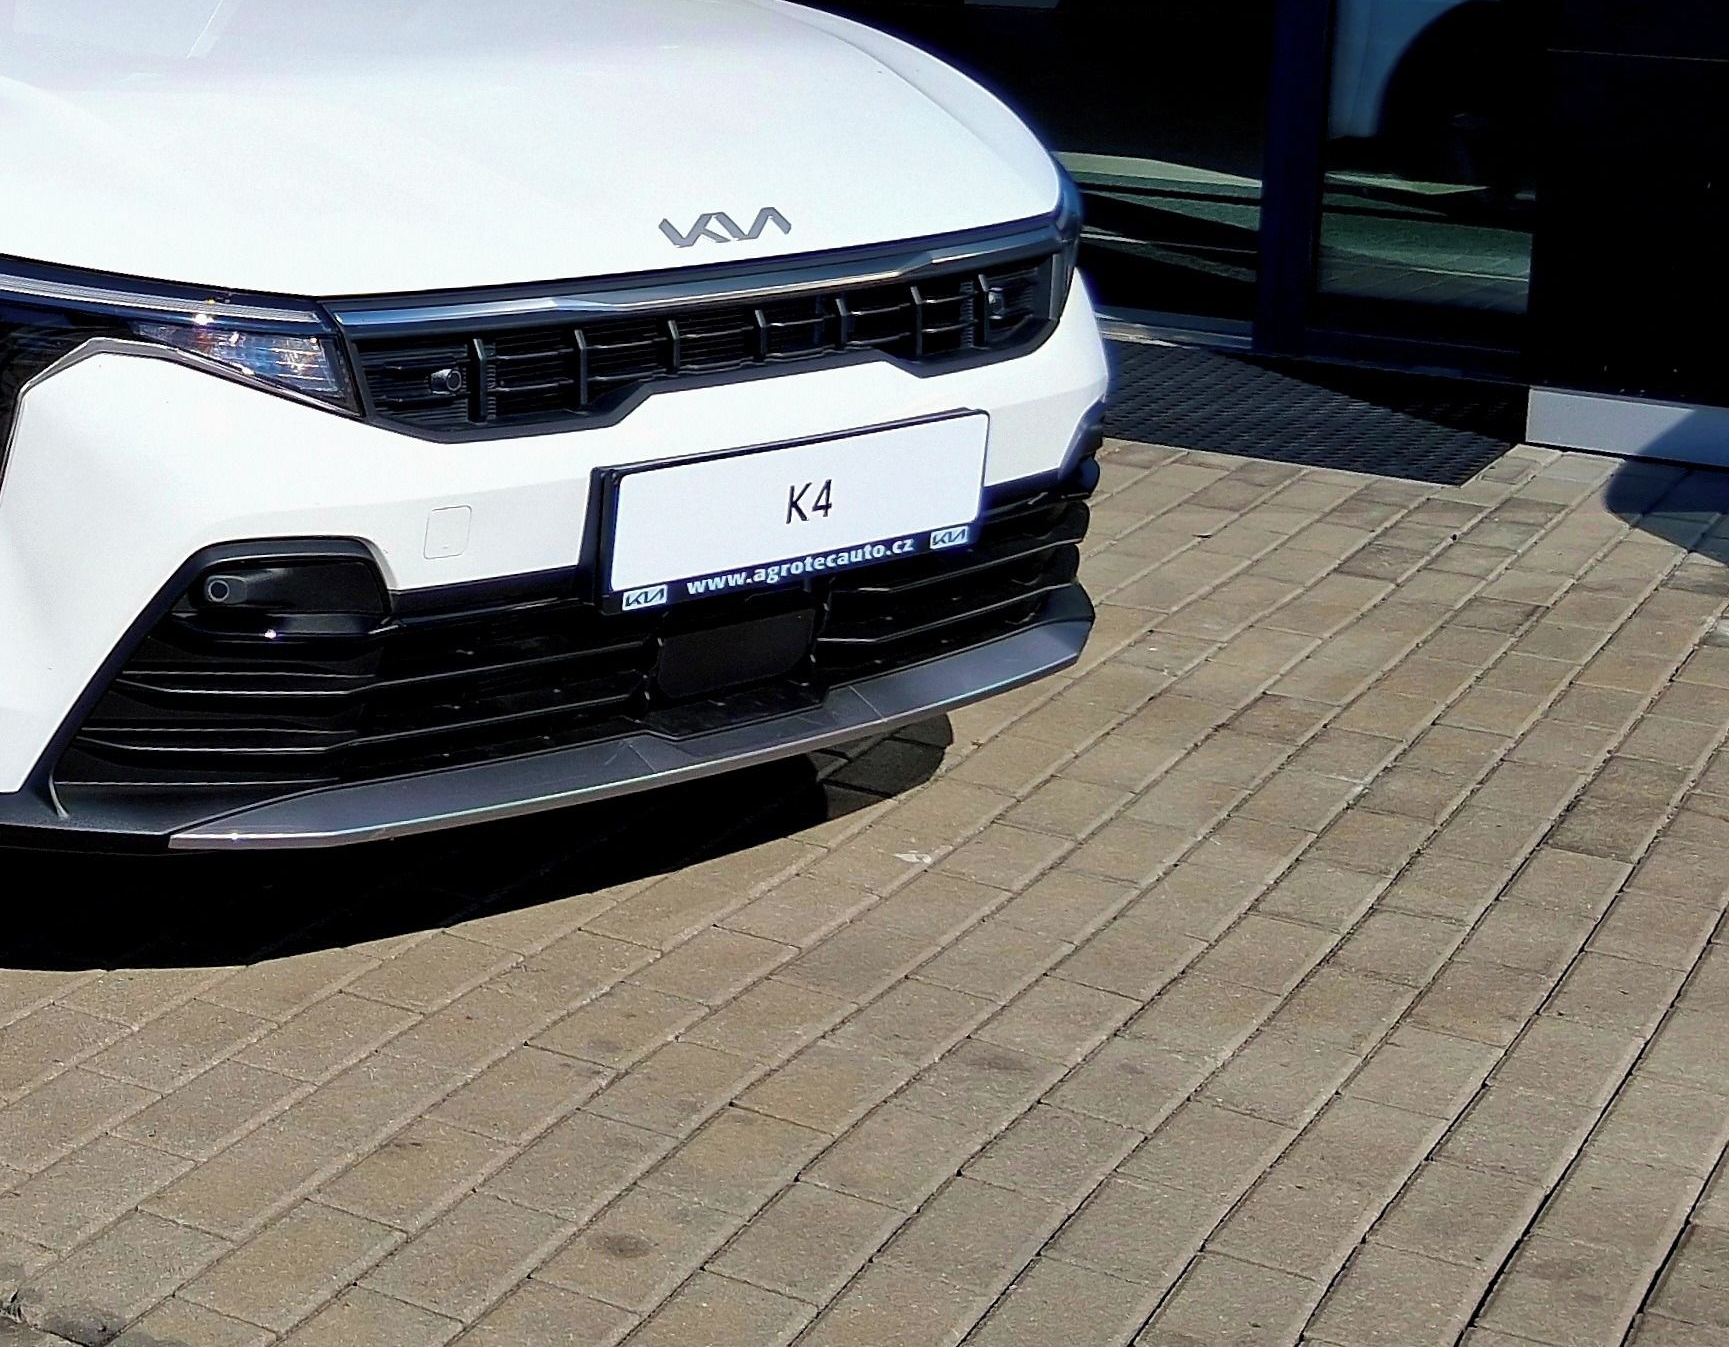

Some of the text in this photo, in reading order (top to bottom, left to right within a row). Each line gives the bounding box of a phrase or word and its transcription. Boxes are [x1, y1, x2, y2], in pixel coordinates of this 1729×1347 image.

[658, 206, 792, 249] KIA
[785, 478, 834, 525] K4
[686, 537, 915, 595] www.agrotecauto.cz
